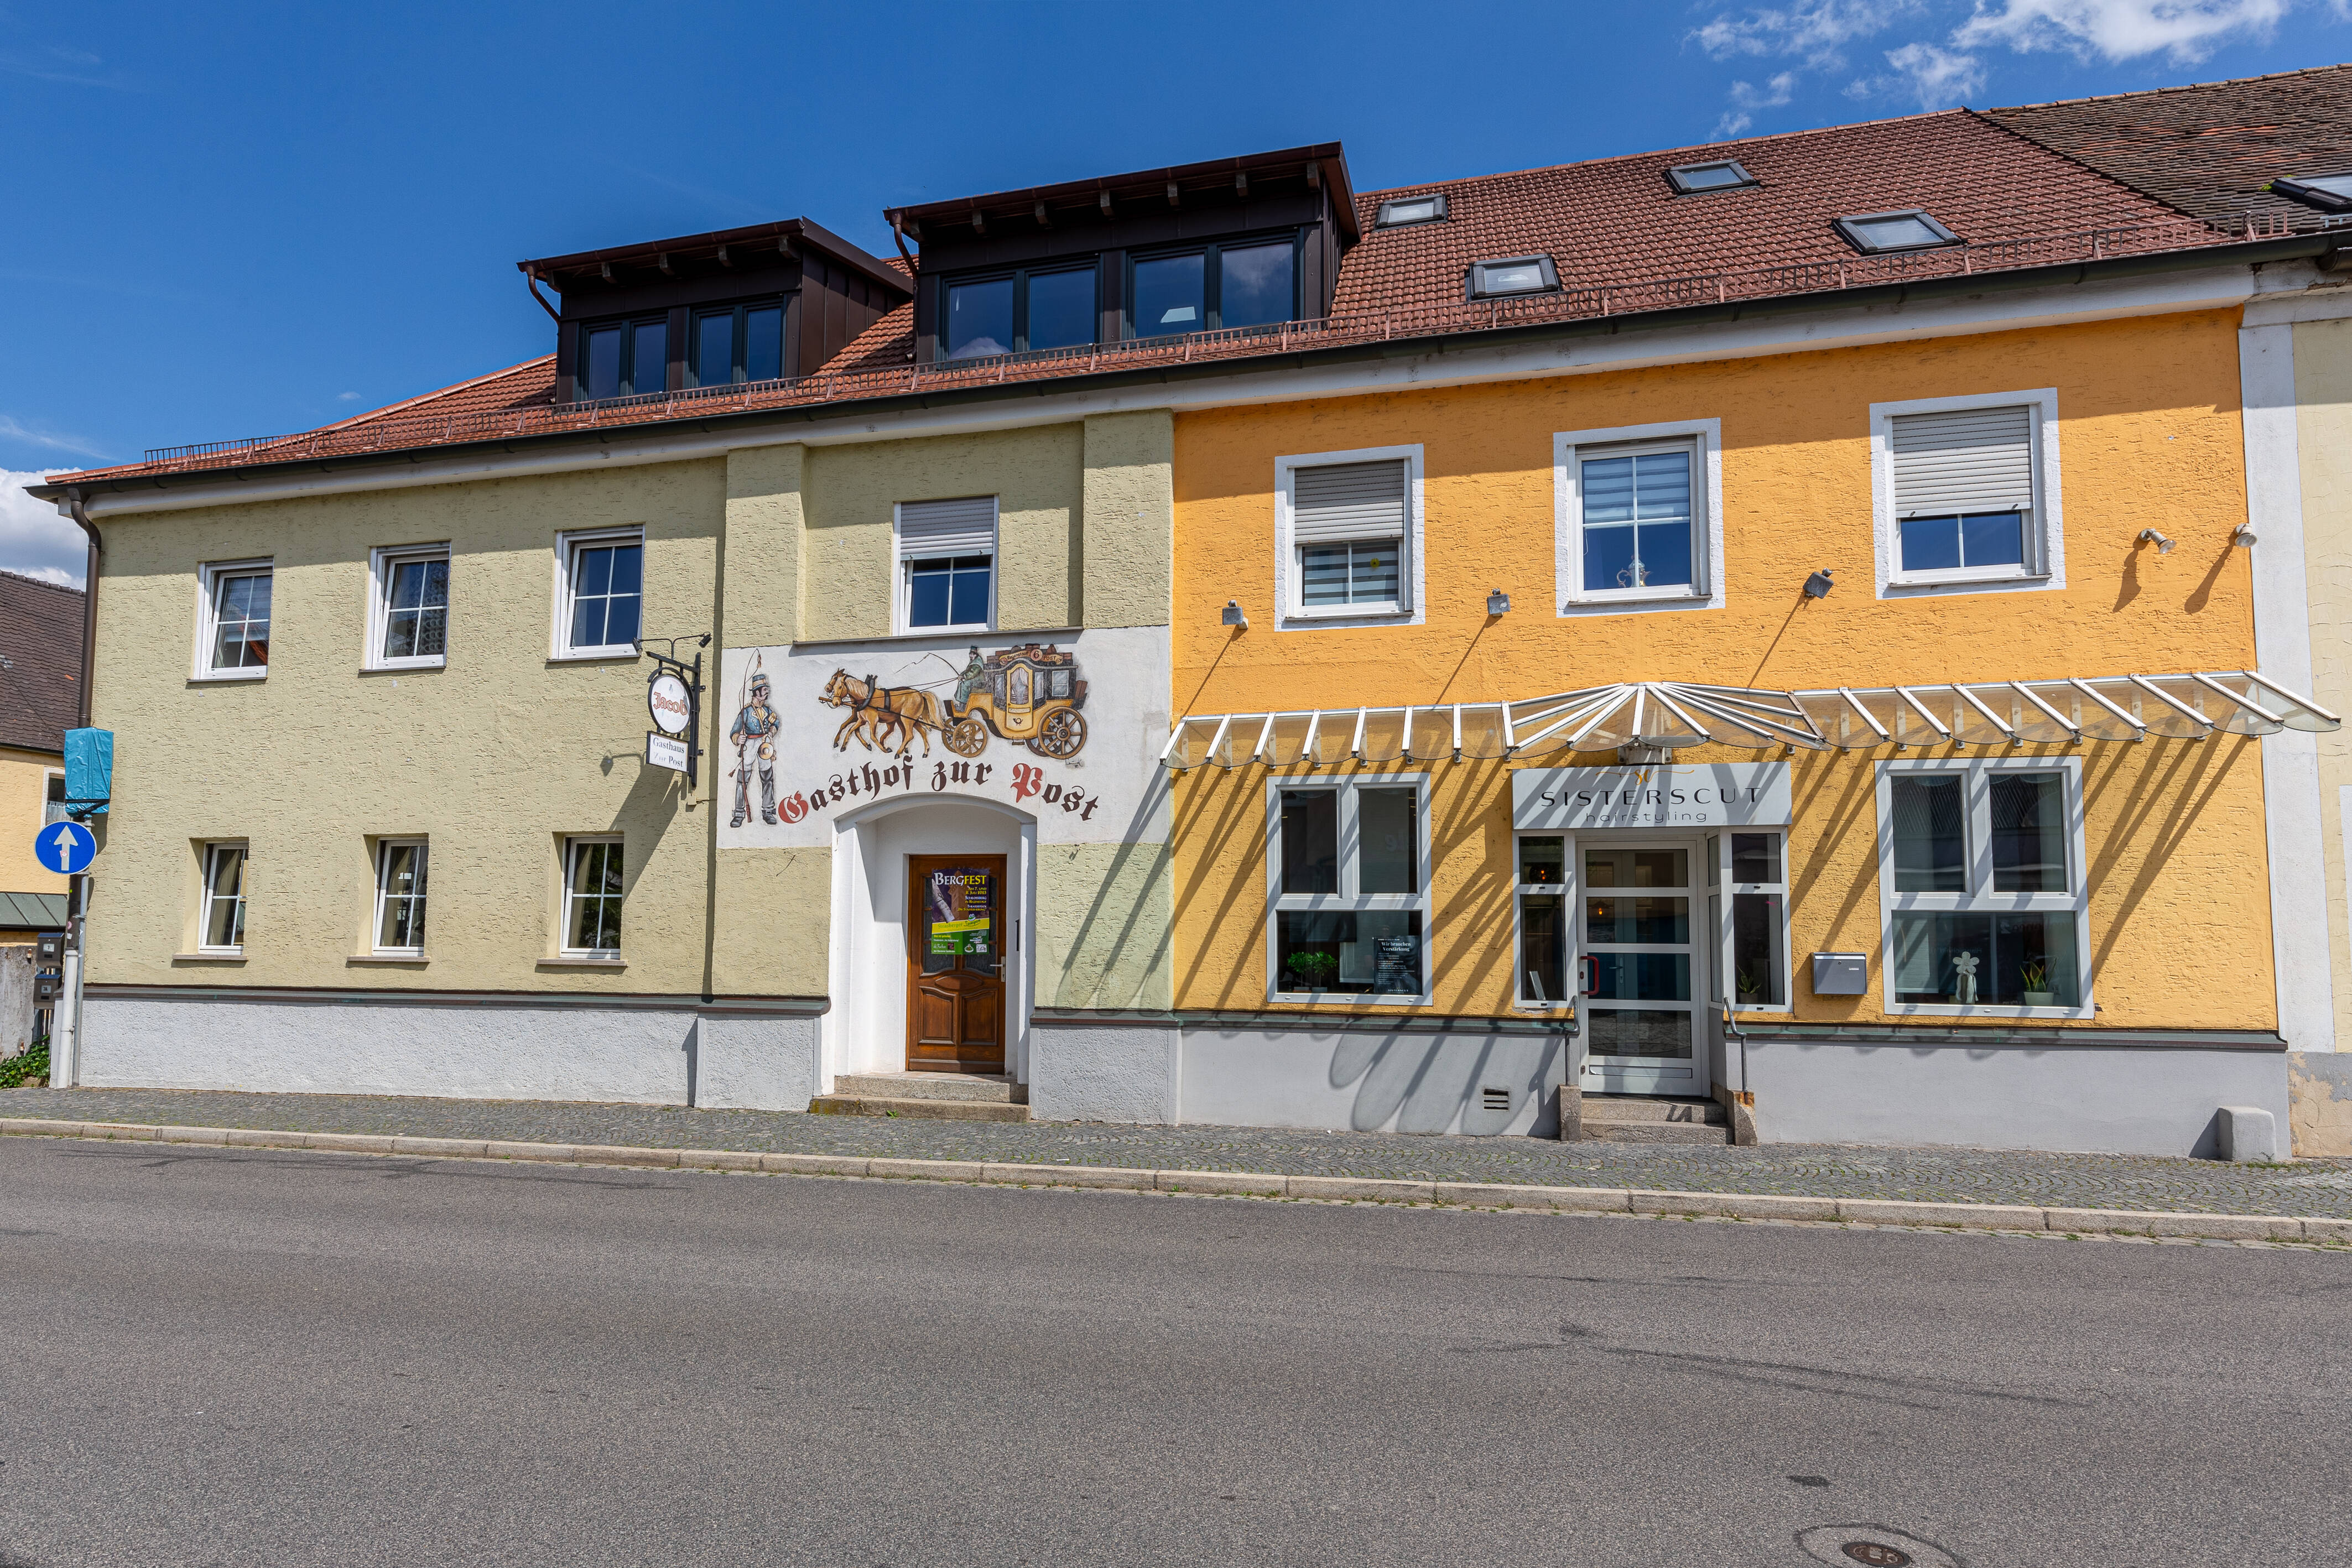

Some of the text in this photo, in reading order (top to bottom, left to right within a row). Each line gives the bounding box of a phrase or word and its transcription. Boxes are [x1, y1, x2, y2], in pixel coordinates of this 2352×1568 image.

[1034, 650, 1039, 659] 6
[653, 691, 688, 716] Jacob
[653, 737, 685, 754] Gasthaus
[668, 756, 683, 768] Post
[778, 754, 1099, 824] Gasthof zur Post
[1540, 786, 1761, 808] SISTERSCUT
[1585, 811, 1707, 824] hairstyling
